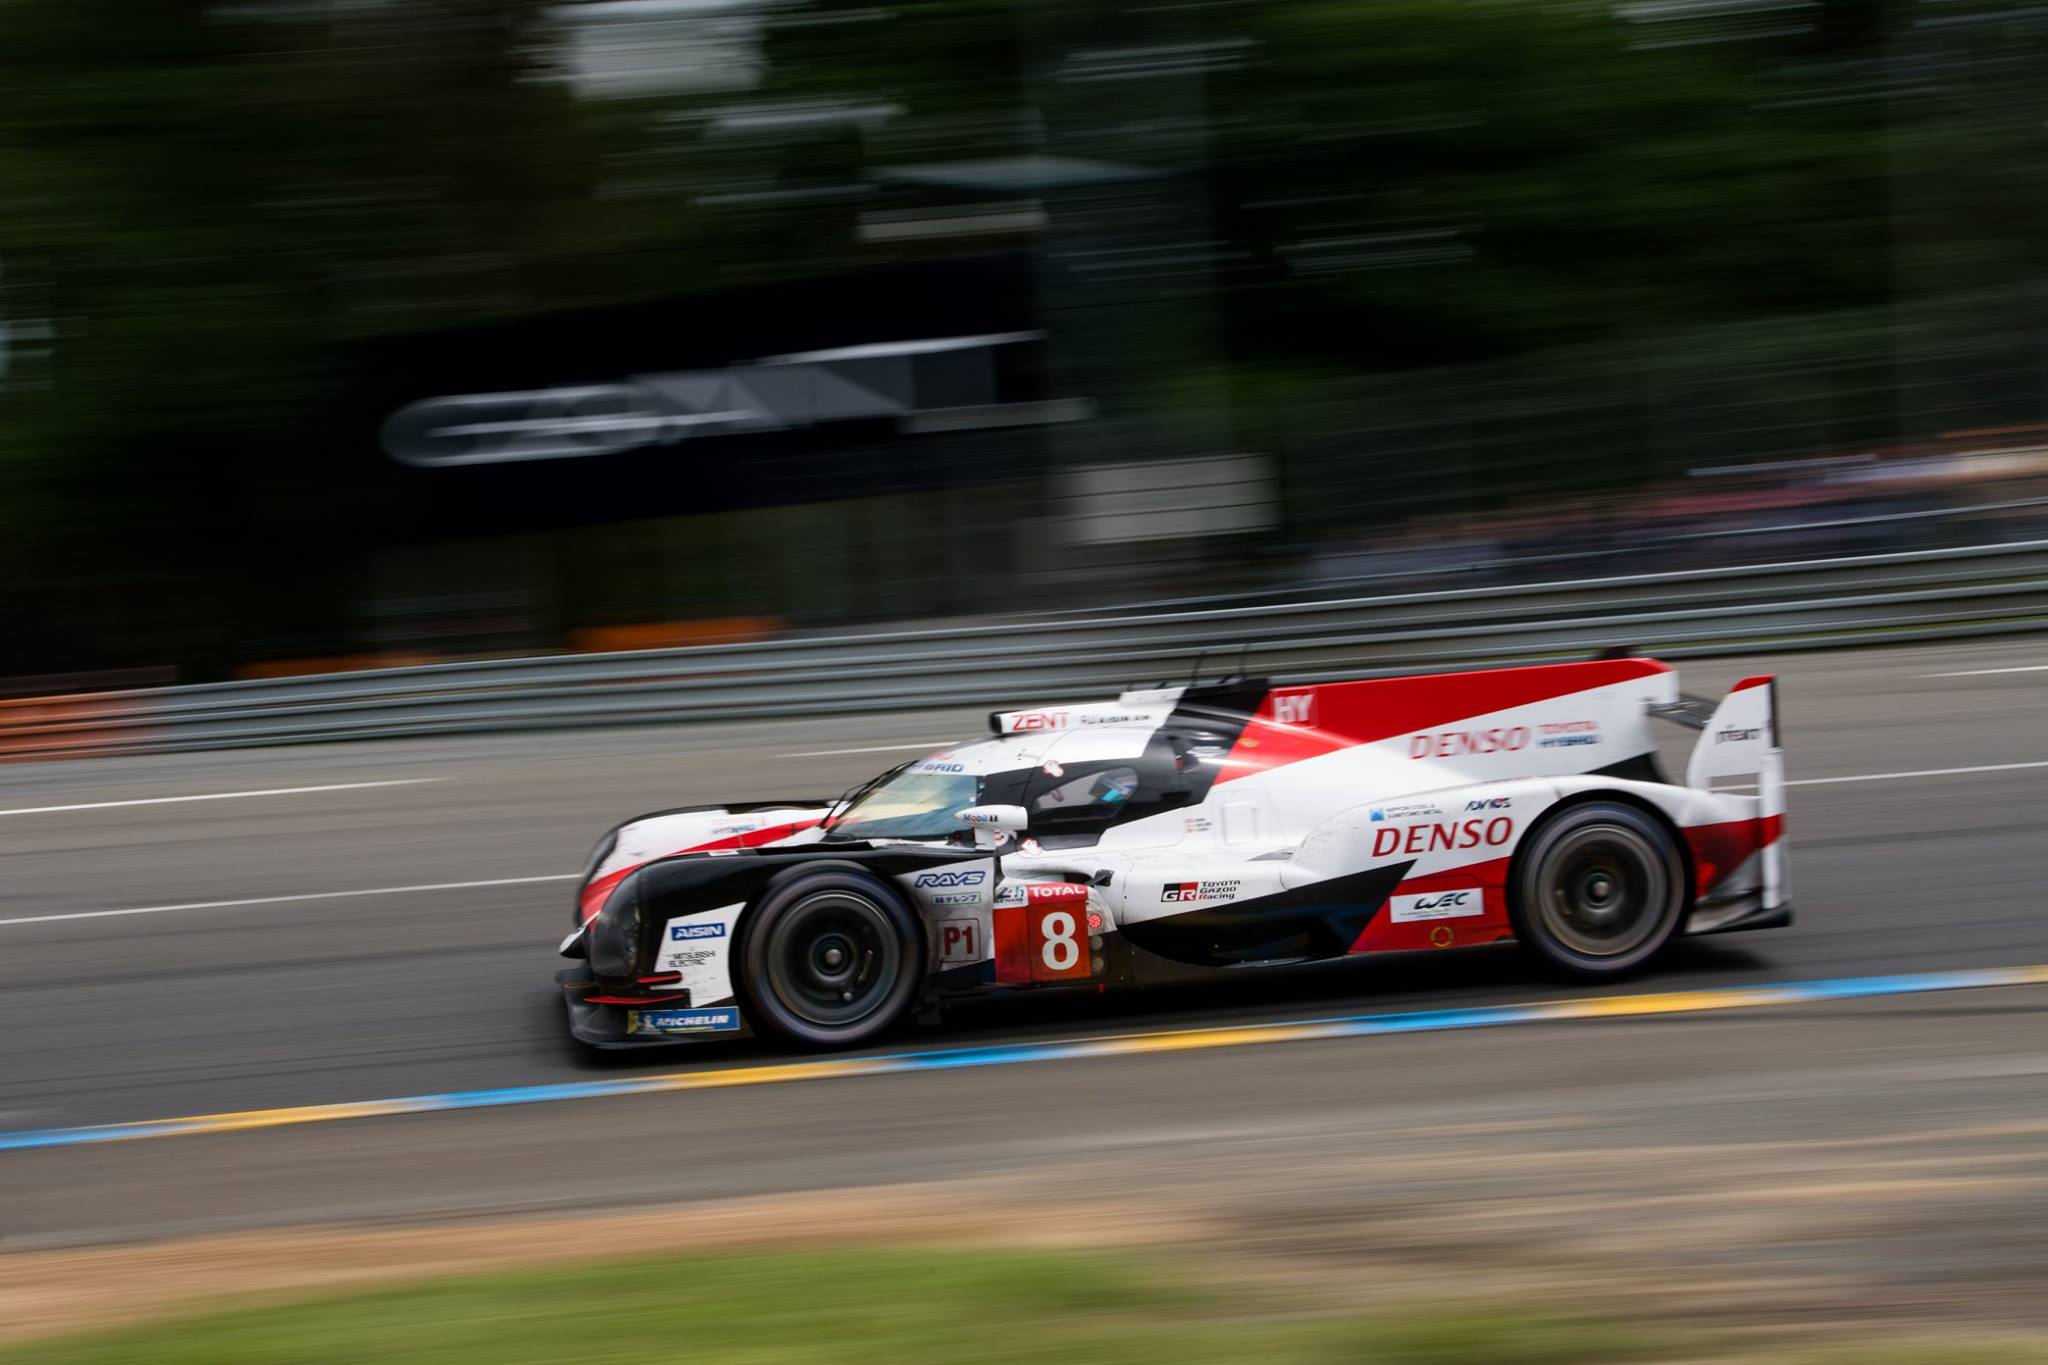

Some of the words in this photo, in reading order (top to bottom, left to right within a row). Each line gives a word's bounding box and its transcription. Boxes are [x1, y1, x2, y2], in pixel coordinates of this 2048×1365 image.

[1273, 694, 1314, 723] HY
[1012, 712, 1070, 731] ZENT
[1408, 726, 1530, 759] DENSO
[963, 813, 988, 822] Mobil
[1371, 816, 1513, 857] DENSO
[915, 871, 985, 888] RAYS
[1029, 885, 1085, 897] TOTAL
[1162, 889, 1197, 900] GR
[1414, 892, 1470, 910] WEC
[675, 925, 722, 938] AISIN
[1041, 911, 1079, 970] 8
[944, 926, 973, 956] P1
[656, 1015, 729, 1026] MICHELIN
